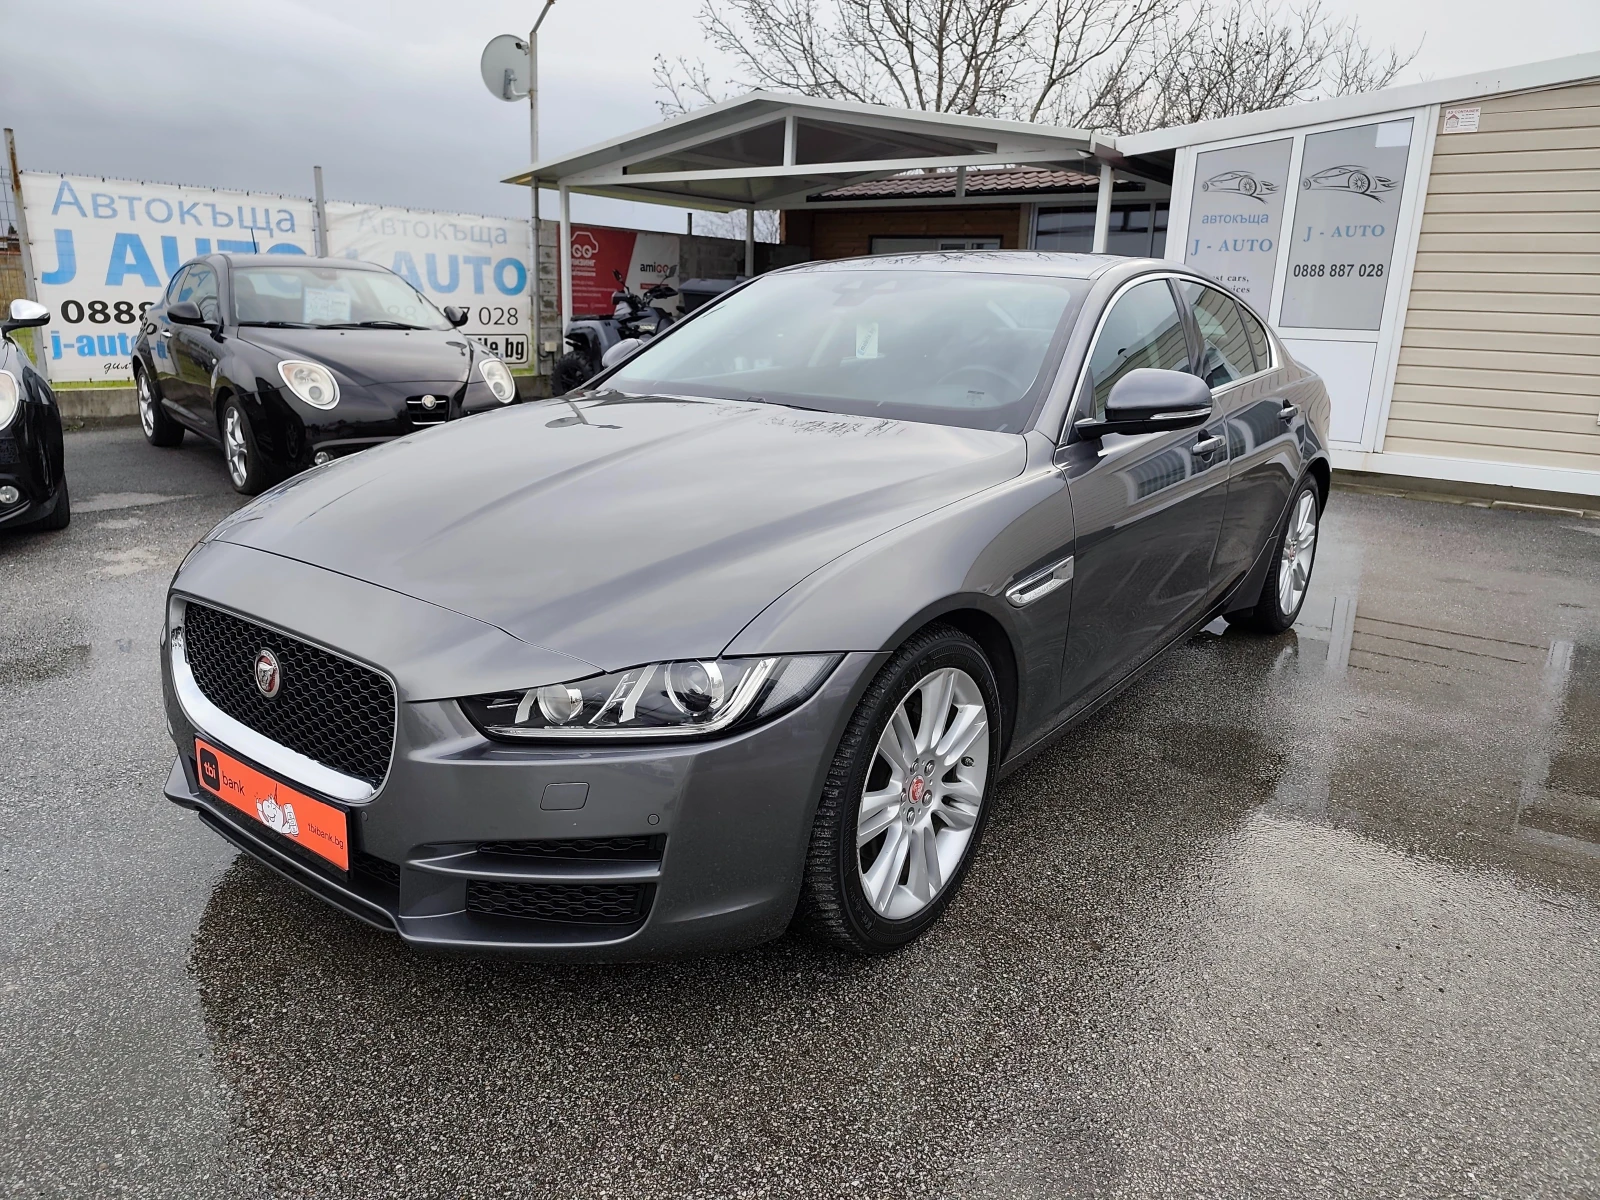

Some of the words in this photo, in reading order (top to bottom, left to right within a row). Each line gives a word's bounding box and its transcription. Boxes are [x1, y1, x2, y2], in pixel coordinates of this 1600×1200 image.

[51, 180, 297, 238] Автокъща
[1201, 211, 1269, 226] автокъща
[357, 211, 508, 247] Автокъща
[1303, 225, 1313, 243] J
[1331, 224, 1386, 238] AUTO
[41, 228, 77, 286] J
[1191, 238, 1201, 257] J
[1218, 239, 1274, 253] AUTO
[391, 250, 528, 297] AUTO
[1227, 275, 1250, 283] cars,
[1293, 264, 1326, 279] 0888
[1329, 263, 1354, 278] 887
[1358, 263, 1385, 278] 028
[478, 306, 519, 326] 028
[203, 761, 216, 781] tbi
[221, 770, 246, 796] bank
[307, 823, 345, 850] tbibank.bg
